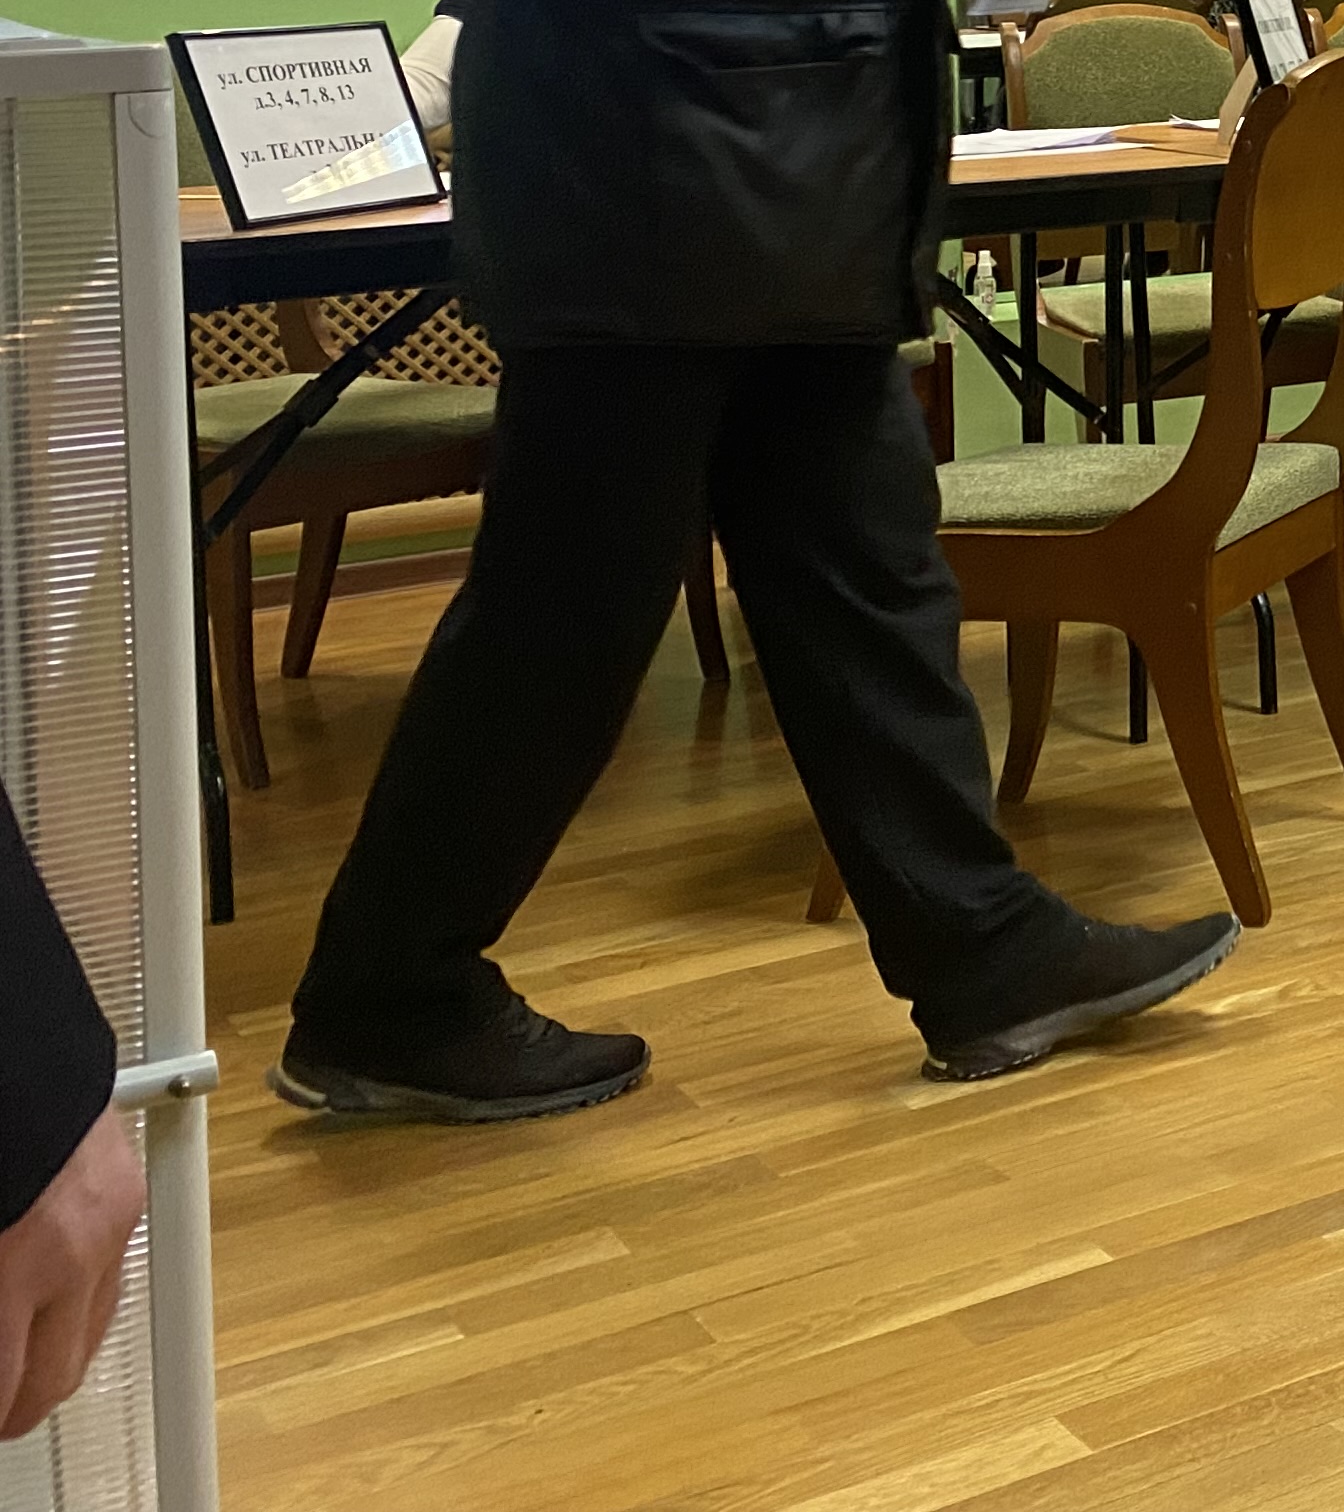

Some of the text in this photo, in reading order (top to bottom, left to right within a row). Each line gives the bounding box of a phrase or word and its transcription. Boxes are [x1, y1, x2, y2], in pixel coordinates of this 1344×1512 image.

[217, 57, 373, 90] ул. СПОРТИВНАЯ
[284, 89, 300, 107] 4,
[300, 88, 318, 108] 7,
[318, 86, 336, 105] 8,
[337, 84, 356, 101] 13
[240, 150, 266, 168] ул.
